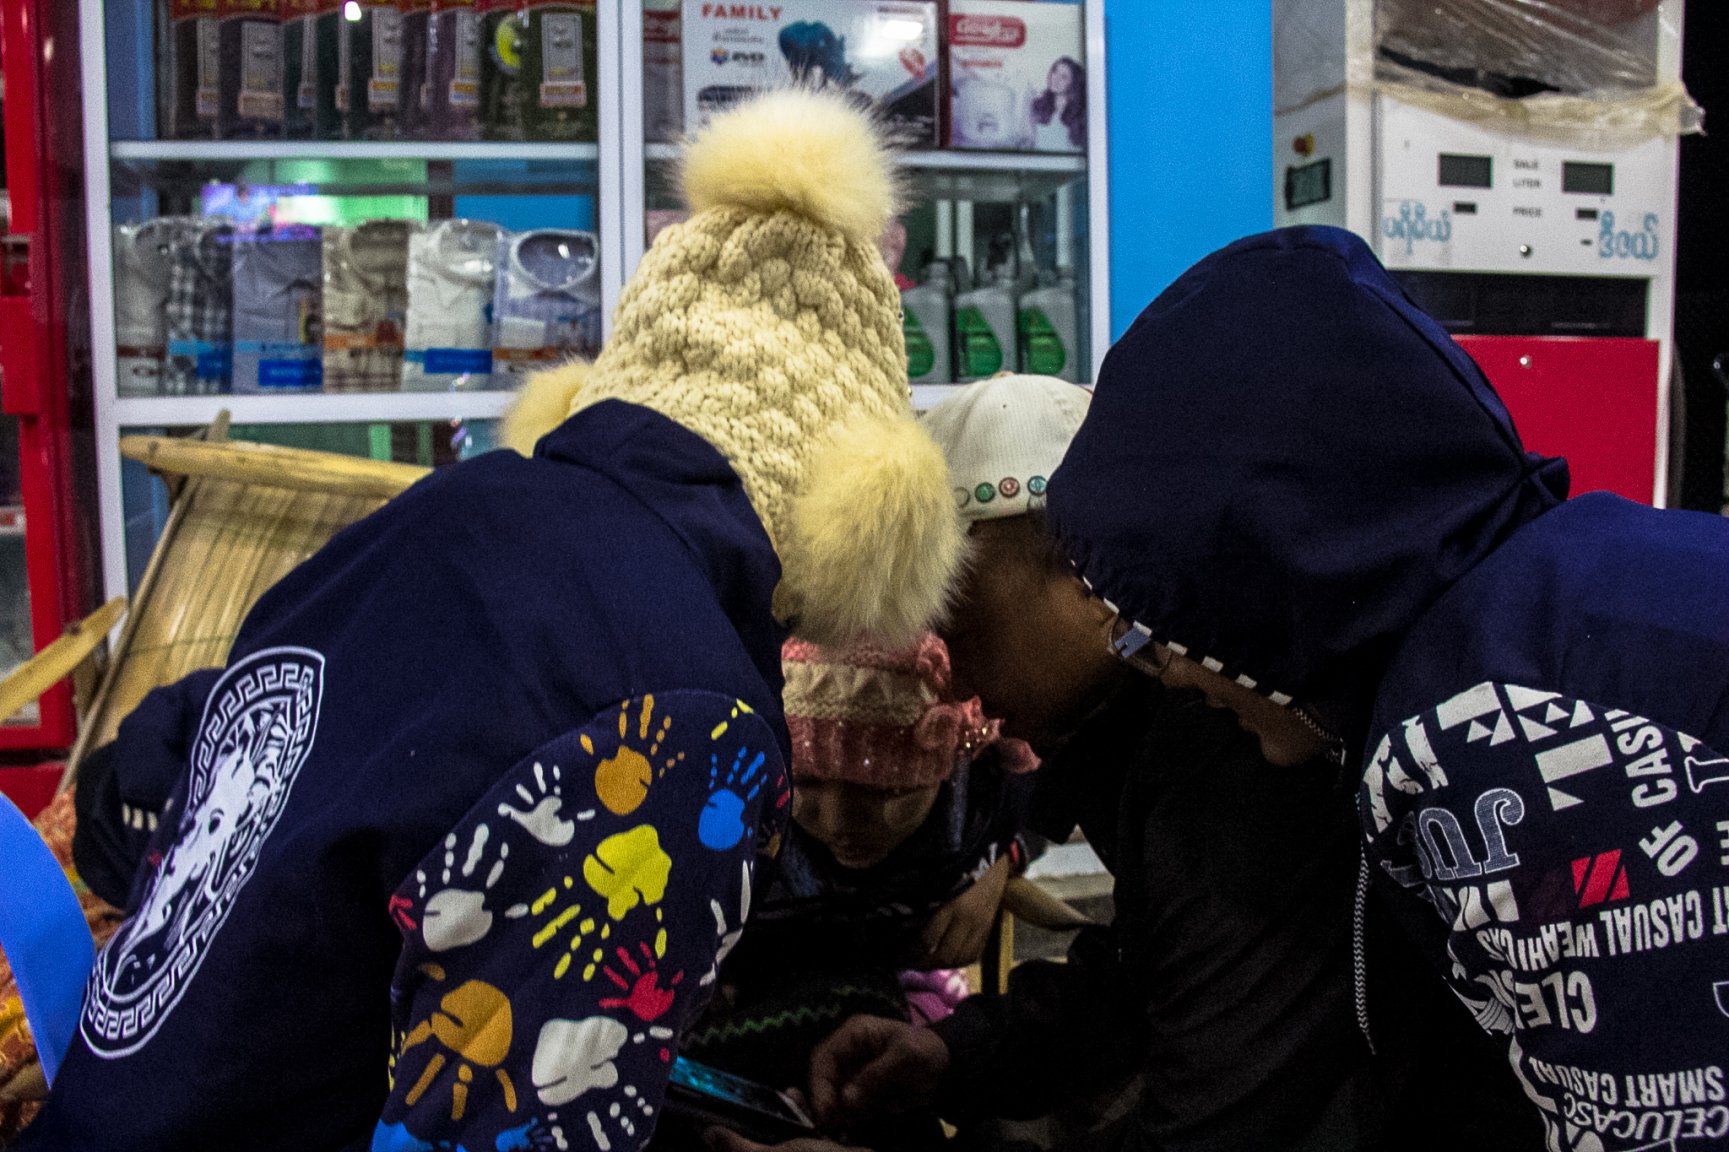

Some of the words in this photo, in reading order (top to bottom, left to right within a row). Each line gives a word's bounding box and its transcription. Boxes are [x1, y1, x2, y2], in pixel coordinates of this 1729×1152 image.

[701, 3, 782, 20] FAMILY
[1412, 787, 1525, 881] JU
[1638, 819, 1699, 877] OF
[1599, 890, 1704, 956] CASUAL
[1528, 1056, 1618, 1106] CASUAL
[1625, 1065, 1726, 1108] SMART
